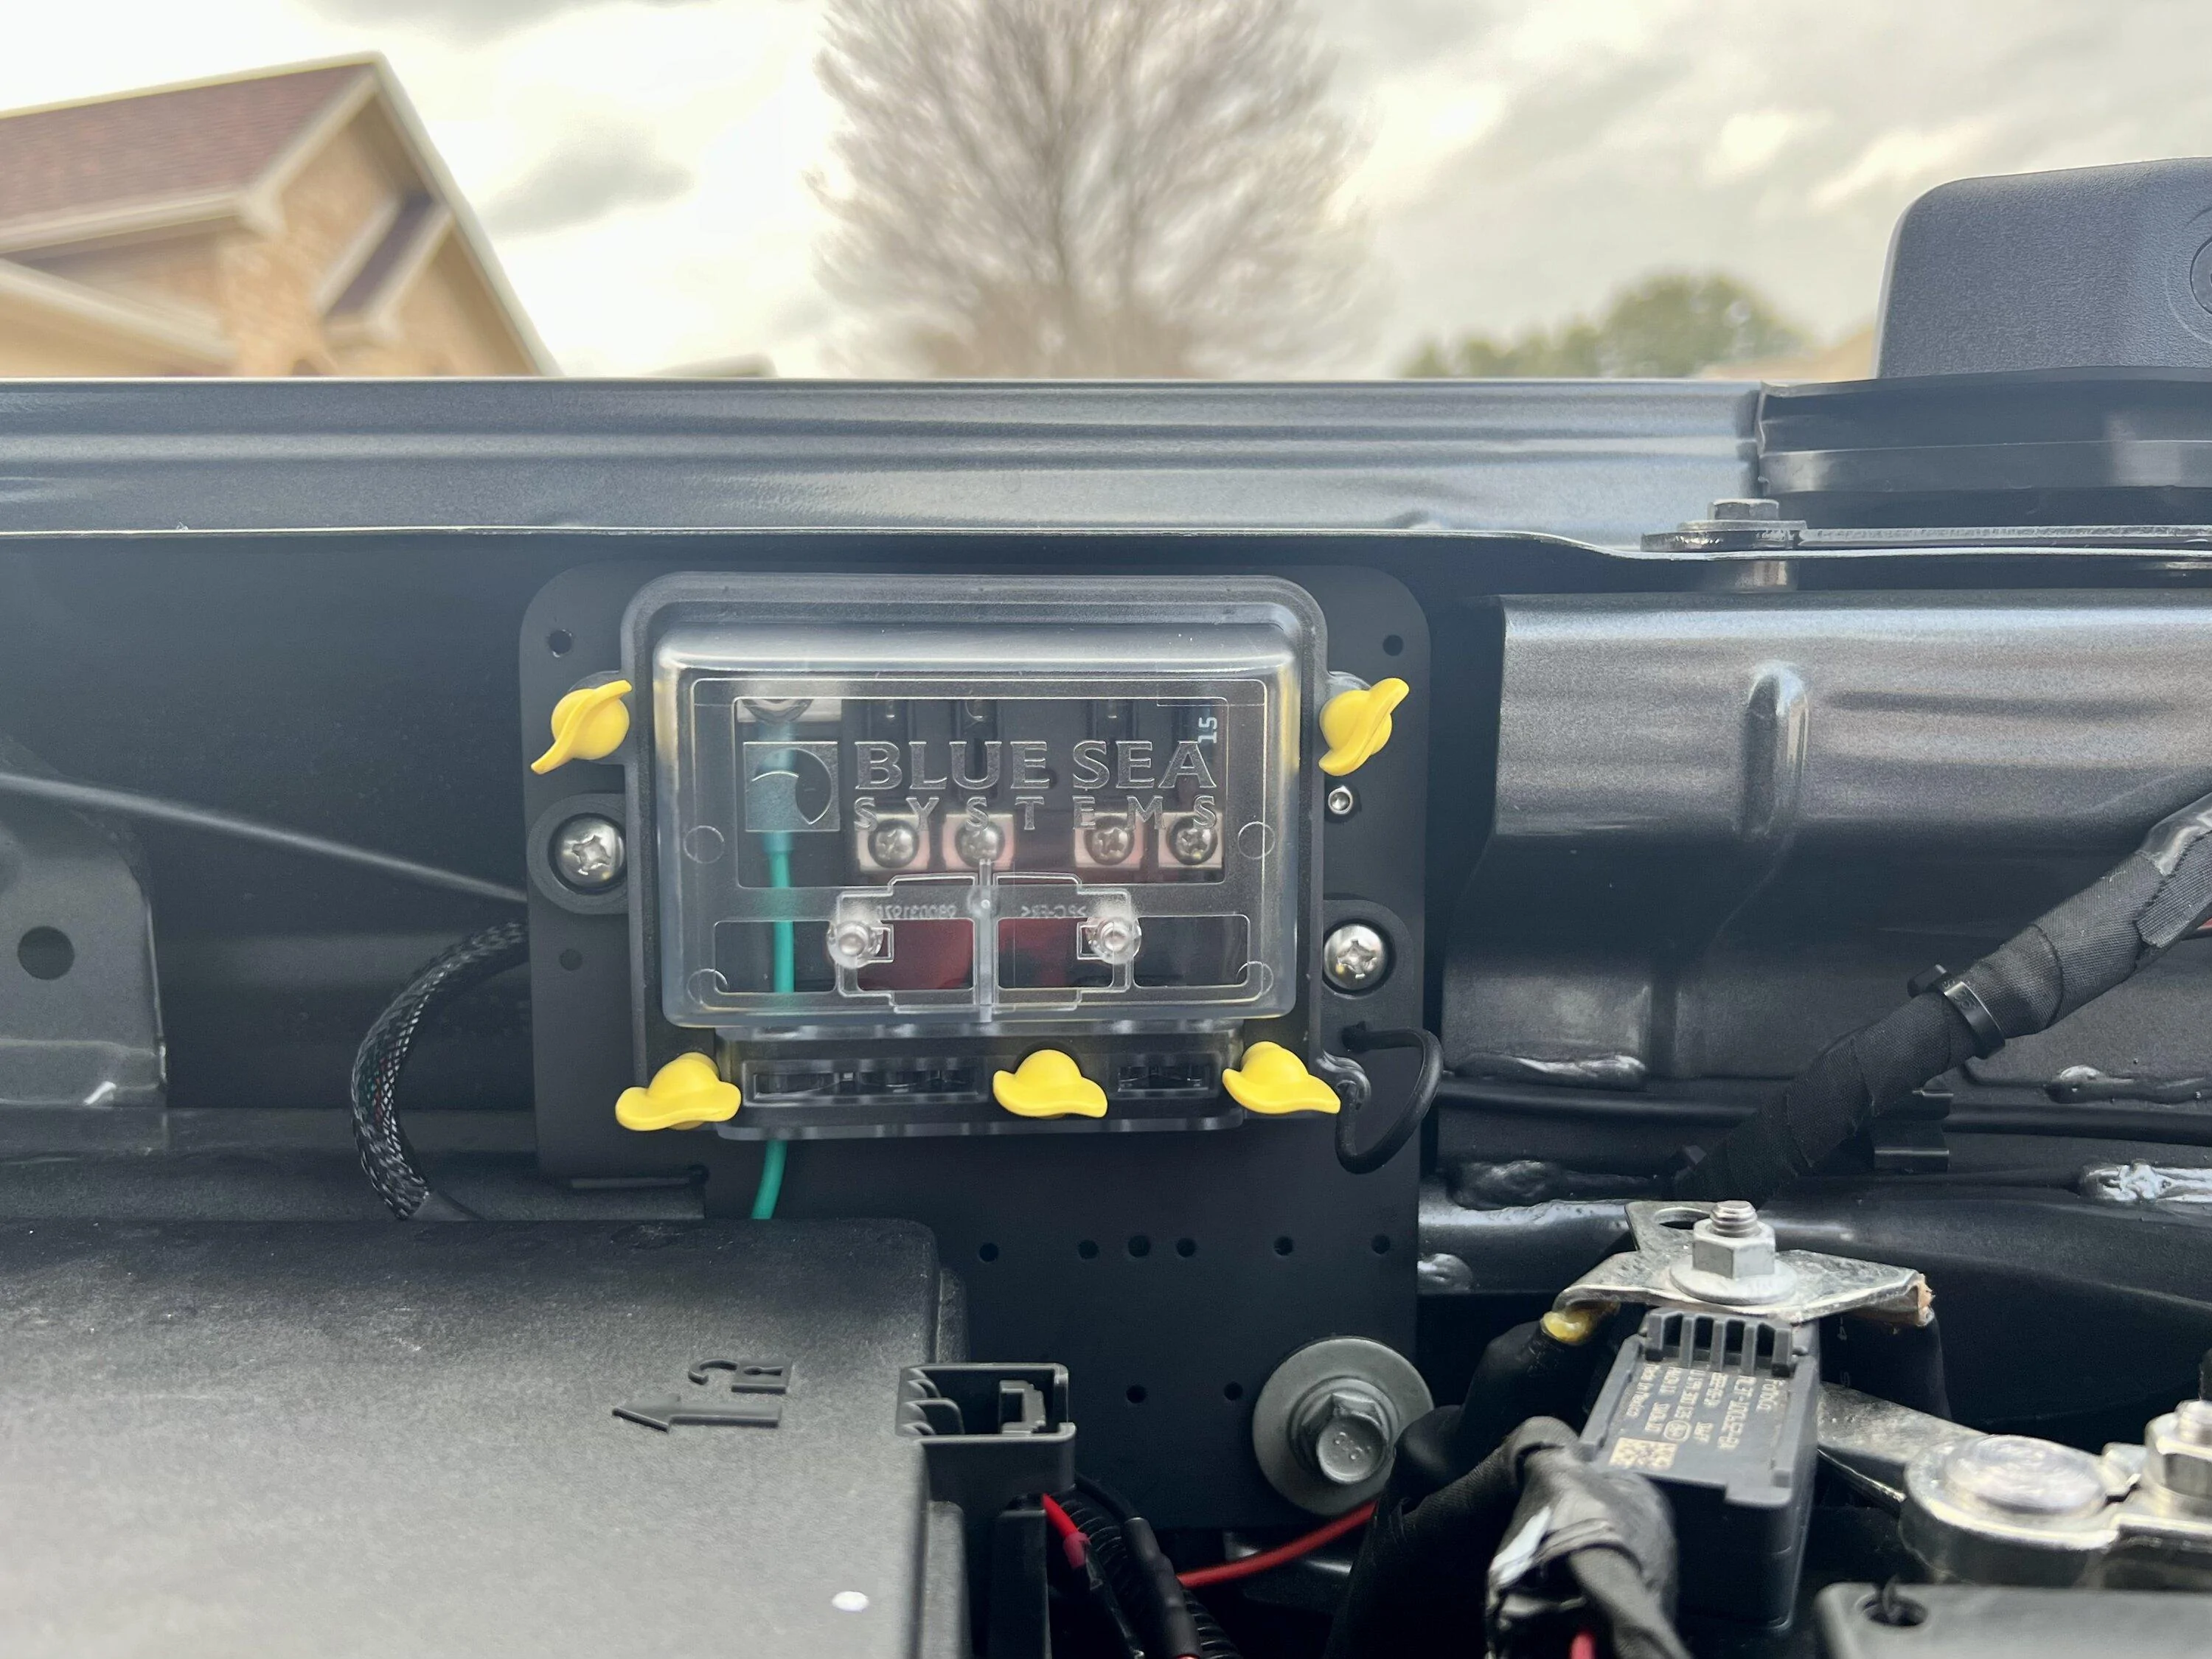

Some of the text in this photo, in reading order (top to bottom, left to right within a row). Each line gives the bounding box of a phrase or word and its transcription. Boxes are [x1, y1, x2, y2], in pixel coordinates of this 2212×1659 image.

[1198, 716, 1217, 744] 15
[855, 740, 1217, 790] BLUE SEA
[853, 795, 1217, 831] SYSTEMS
[1755, 1378, 1786, 1412] FoMoCo
